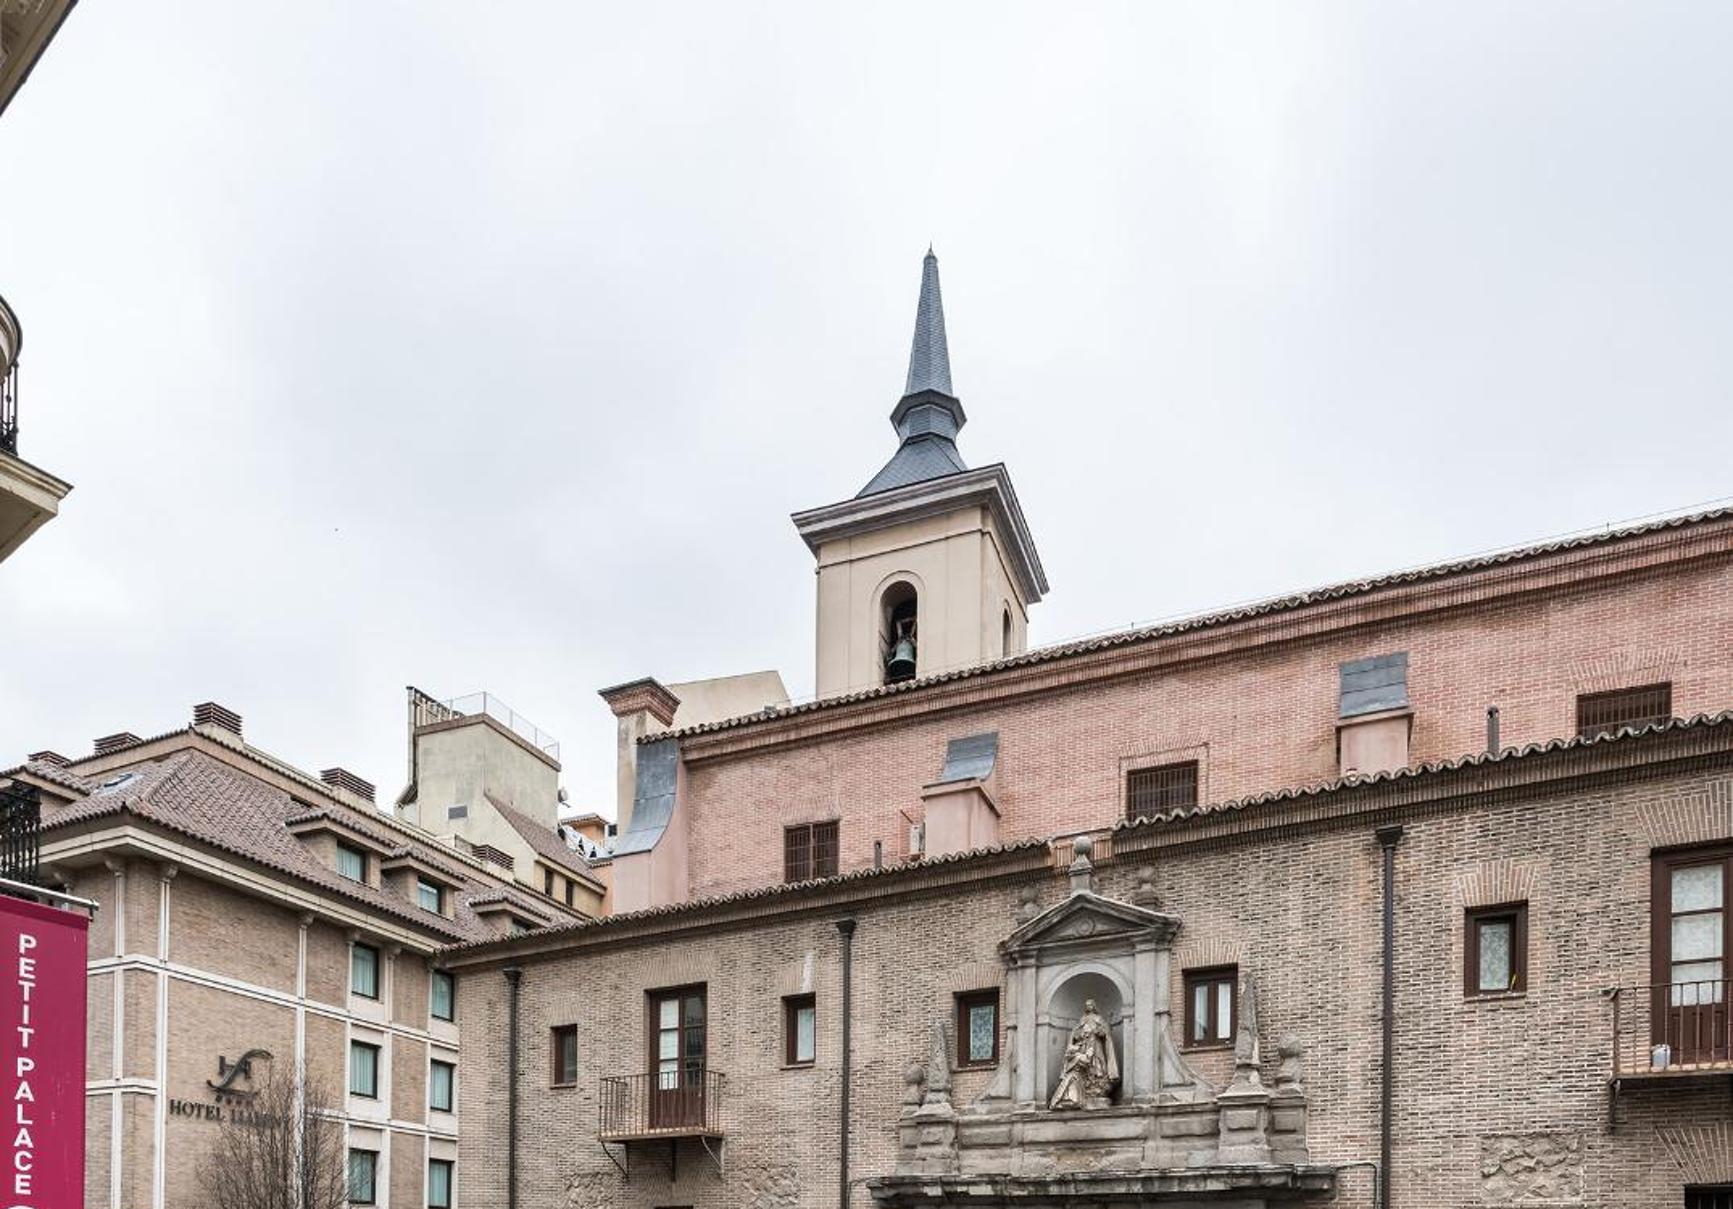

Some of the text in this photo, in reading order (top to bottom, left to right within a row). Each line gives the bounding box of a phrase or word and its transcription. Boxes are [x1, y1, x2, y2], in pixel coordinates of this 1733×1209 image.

[13, 933, 37, 1195] PETIT PALACE
[169, 1099, 226, 1121] HOTEL
